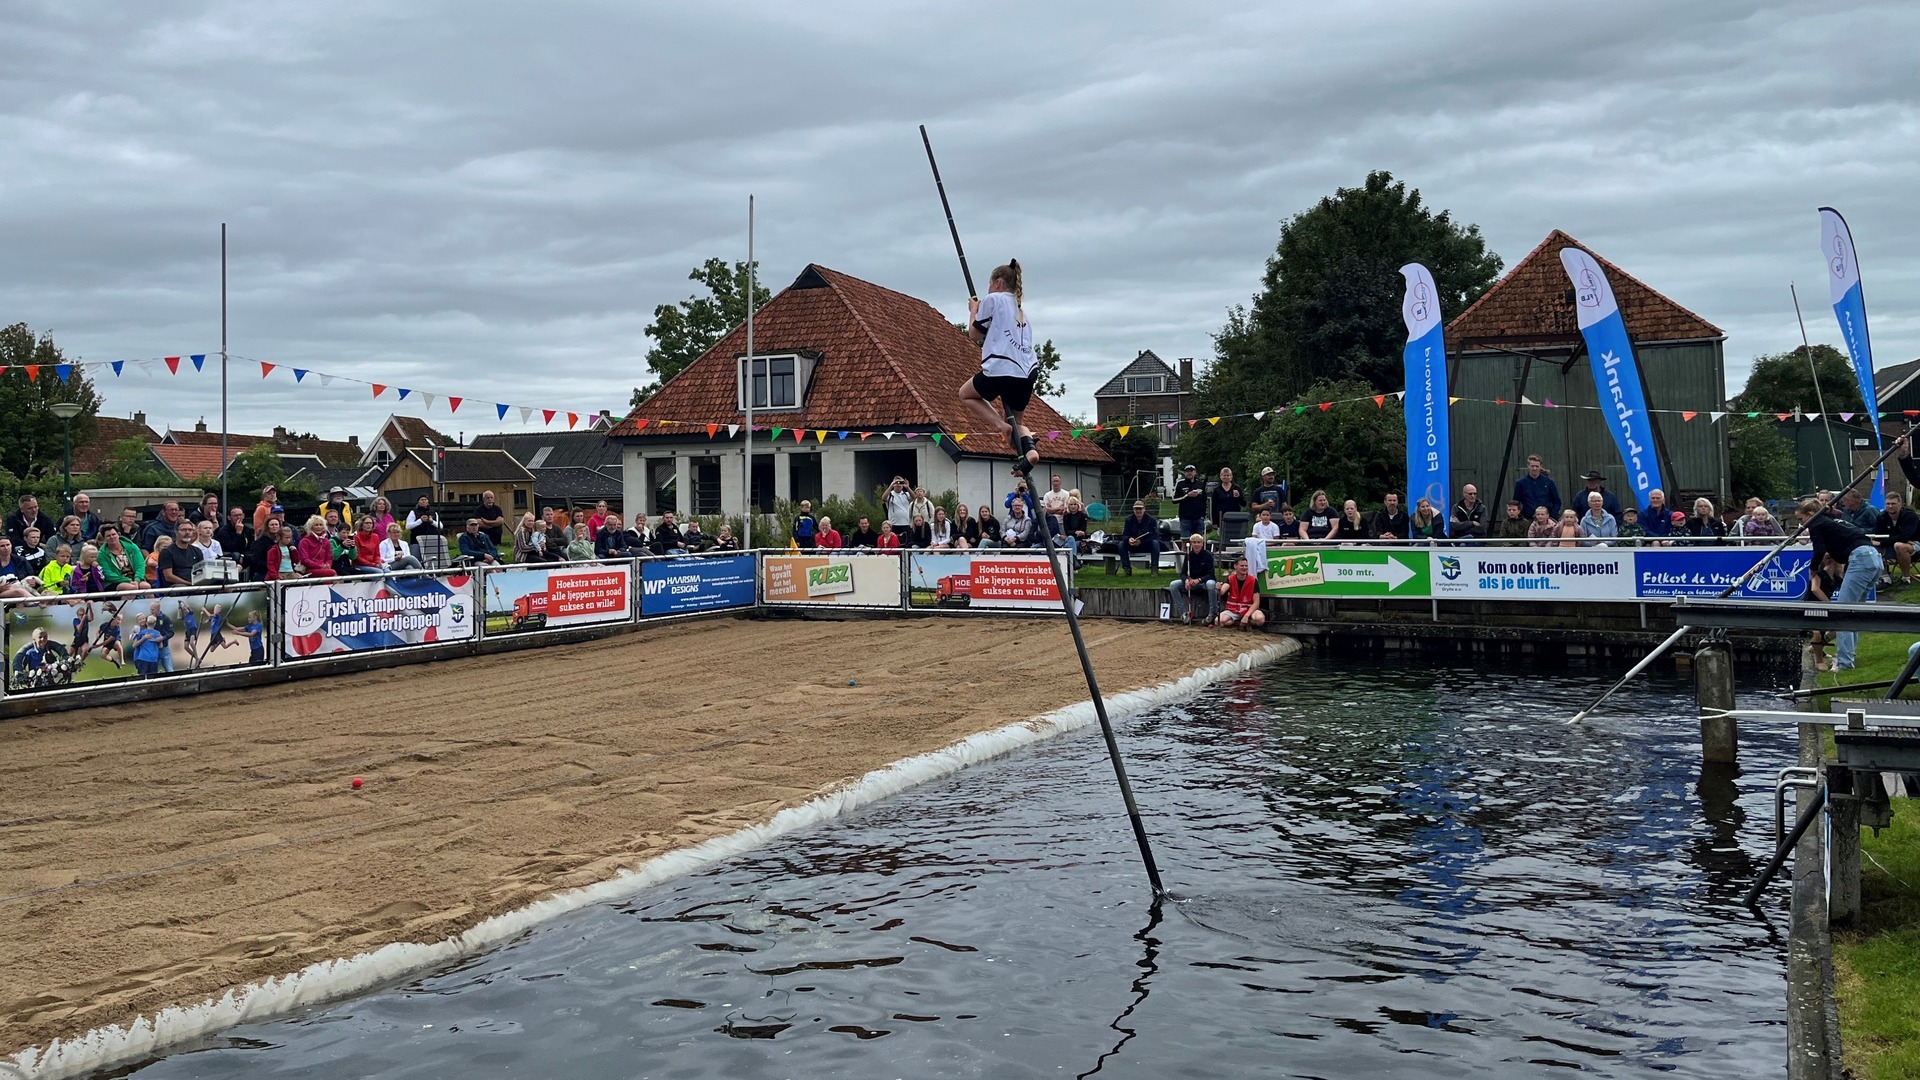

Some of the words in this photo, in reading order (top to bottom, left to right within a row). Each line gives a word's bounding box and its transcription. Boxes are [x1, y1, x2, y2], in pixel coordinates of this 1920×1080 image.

[771, 569, 792, 580] opvalt
[979, 565, 1016, 574] Hoekstra
[1017, 565, 1052, 575] winsket
[1337, 568, 1353, 576] 300
[1356, 569, 1375, 577] mtr.
[1478, 561, 1507, 575] Kom
[1510, 561, 1535, 575] ook
[1537, 561, 1620, 576] fierljeppen!
[556, 579, 589, 589] Hoekstra
[591, 577, 618, 586] winsket
[666, 574, 701, 585] HAARSMA
[974, 576, 990, 584] alle
[991, 576, 1025, 587] ljeppers
[1026, 576, 1035, 585] in
[1037, 576, 1057, 586] soad
[1478, 576, 1499, 590] als
[1501, 576, 1514, 591] je
[1517, 576, 1560, 590] durft...
[1643, 571, 1687, 584] Folkert
[1691, 572, 1706, 584] de
[643, 579, 667, 595] WP
[671, 584, 699, 594] DESIGNS
[769, 585, 797, 596] meevalt!
[982, 586, 1012, 595] sukses
[1025, 587, 1049, 596] wille!
[551, 591, 566, 601] alle
[567, 589, 596, 602] ljeppers
[597, 588, 605, 597] in
[606, 587, 622, 596] soad
[318, 597, 358, 619] Frysk
[358, 592, 448, 614] kampioenskip
[531, 597, 548, 605] HOE
[559, 602, 585, 612] sukses
[595, 599, 615, 608] wille!
[1162, 606, 1169, 618] 7
[326, 617, 367, 638] Jeugd
[369, 611, 441, 633] Fierljeppen
